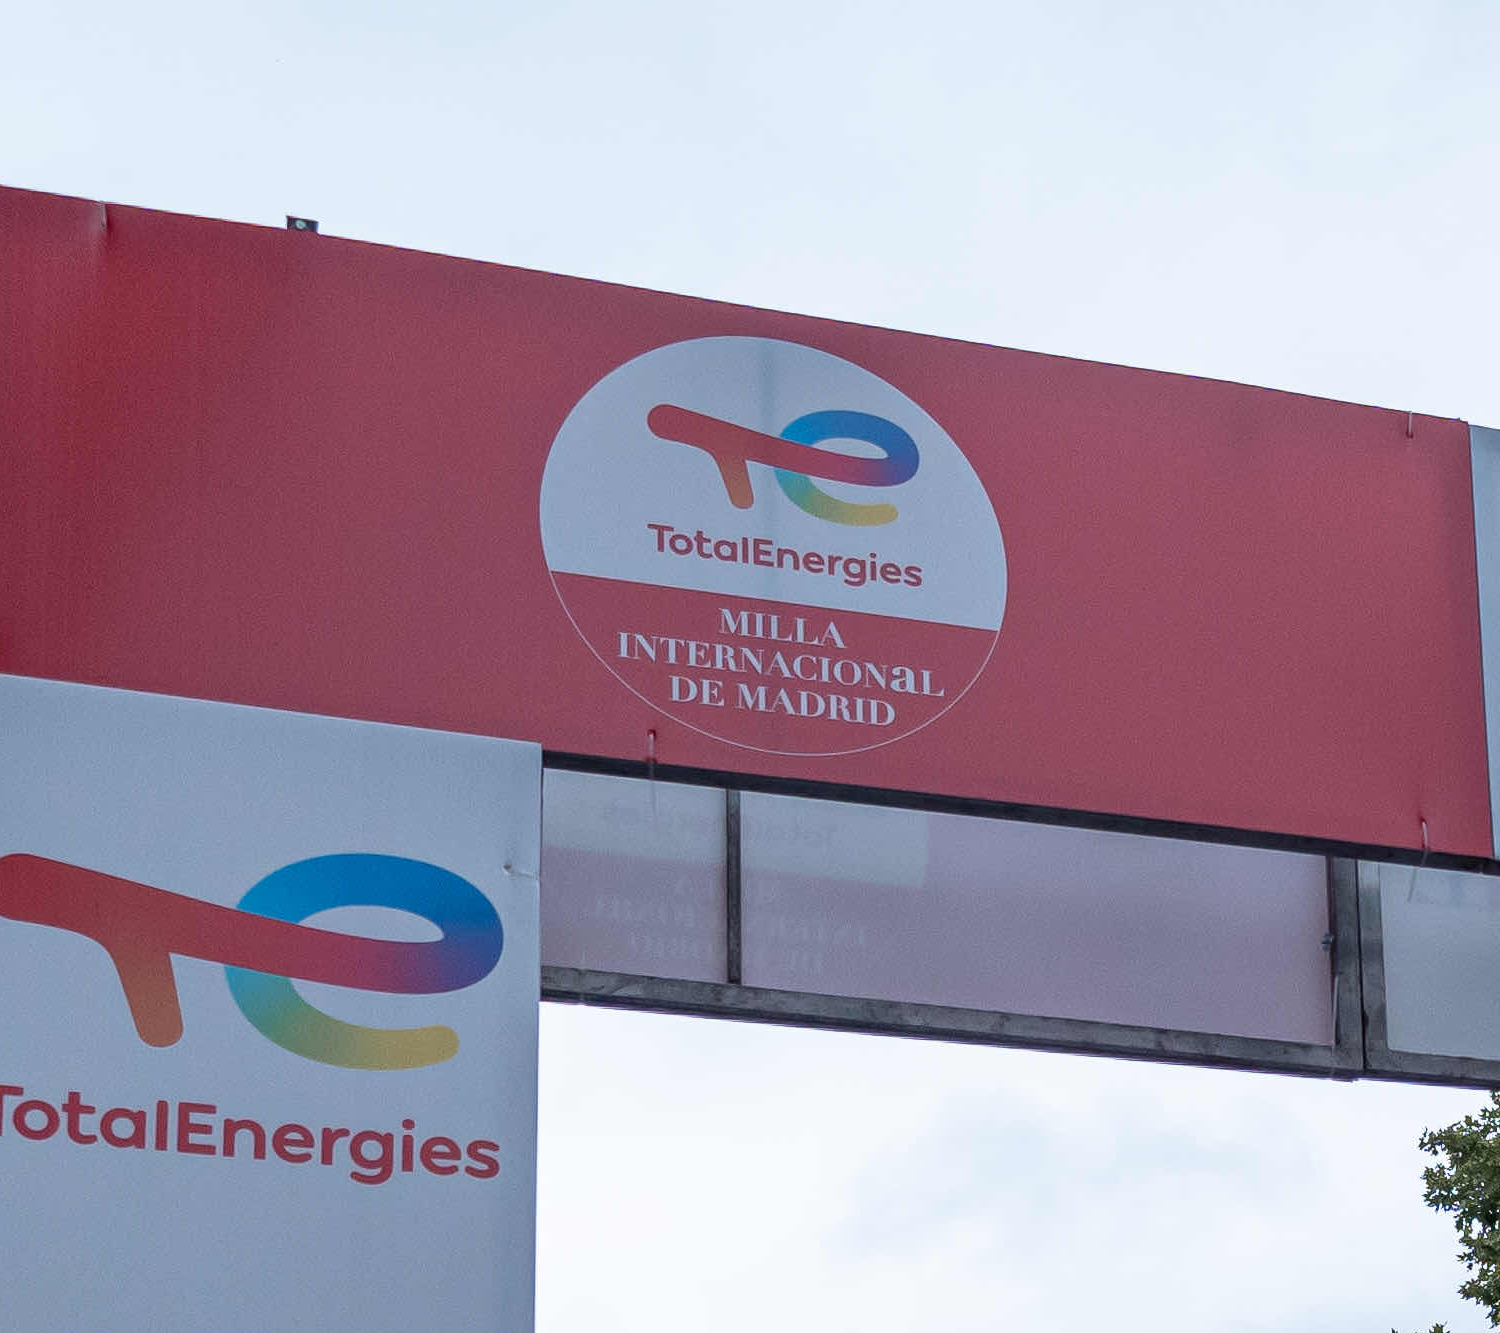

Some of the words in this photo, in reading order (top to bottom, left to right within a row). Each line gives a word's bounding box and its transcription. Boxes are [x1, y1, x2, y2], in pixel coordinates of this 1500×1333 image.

[647, 523, 923, 588] TotalEnergies
[718, 607, 847, 649] MILLA
[670, 675, 725, 706] DE
[737, 683, 896, 727] MADRID
